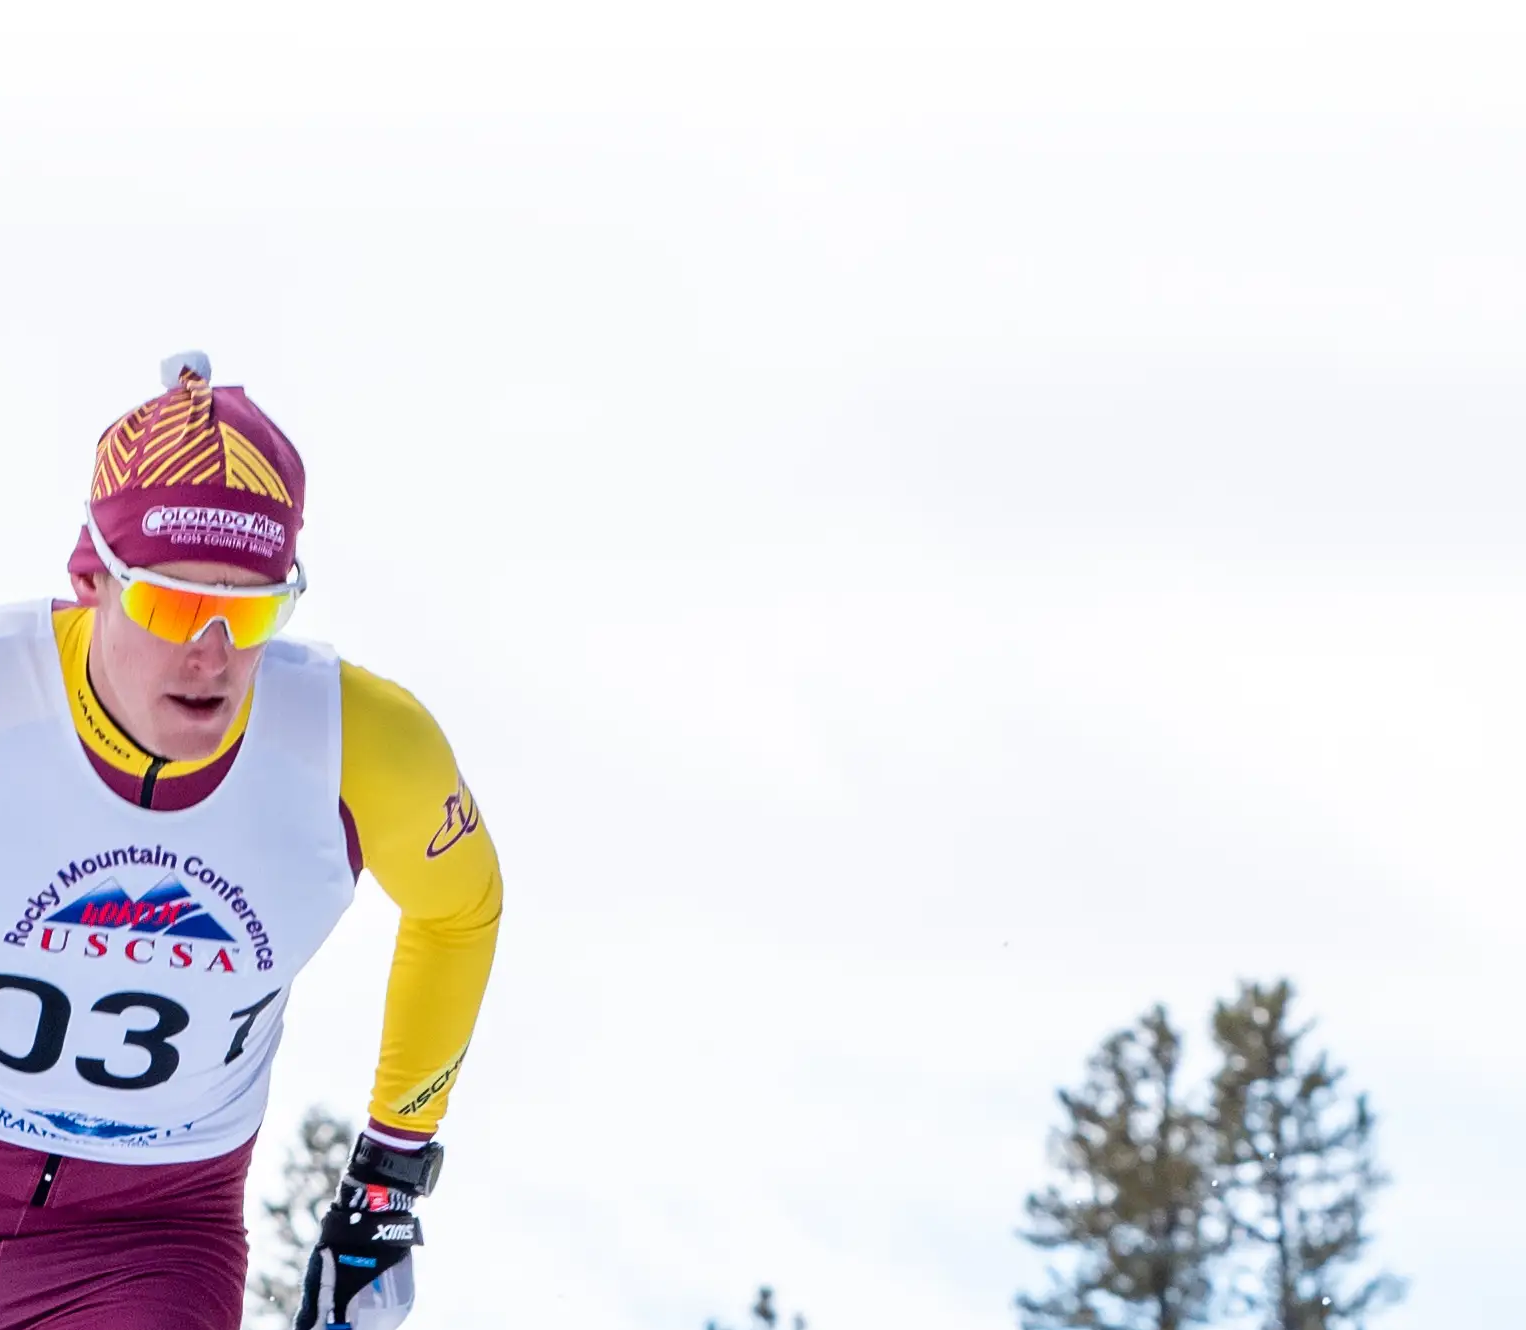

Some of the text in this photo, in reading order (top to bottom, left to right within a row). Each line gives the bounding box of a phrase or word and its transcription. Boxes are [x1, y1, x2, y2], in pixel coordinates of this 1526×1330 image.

[141, 505, 247, 537] COLORADO
[204, 534, 250, 550] COUNTRY
[3, 844, 274, 972] Rocky Mountain Conference
[397, 1050, 465, 1116] FISCH
